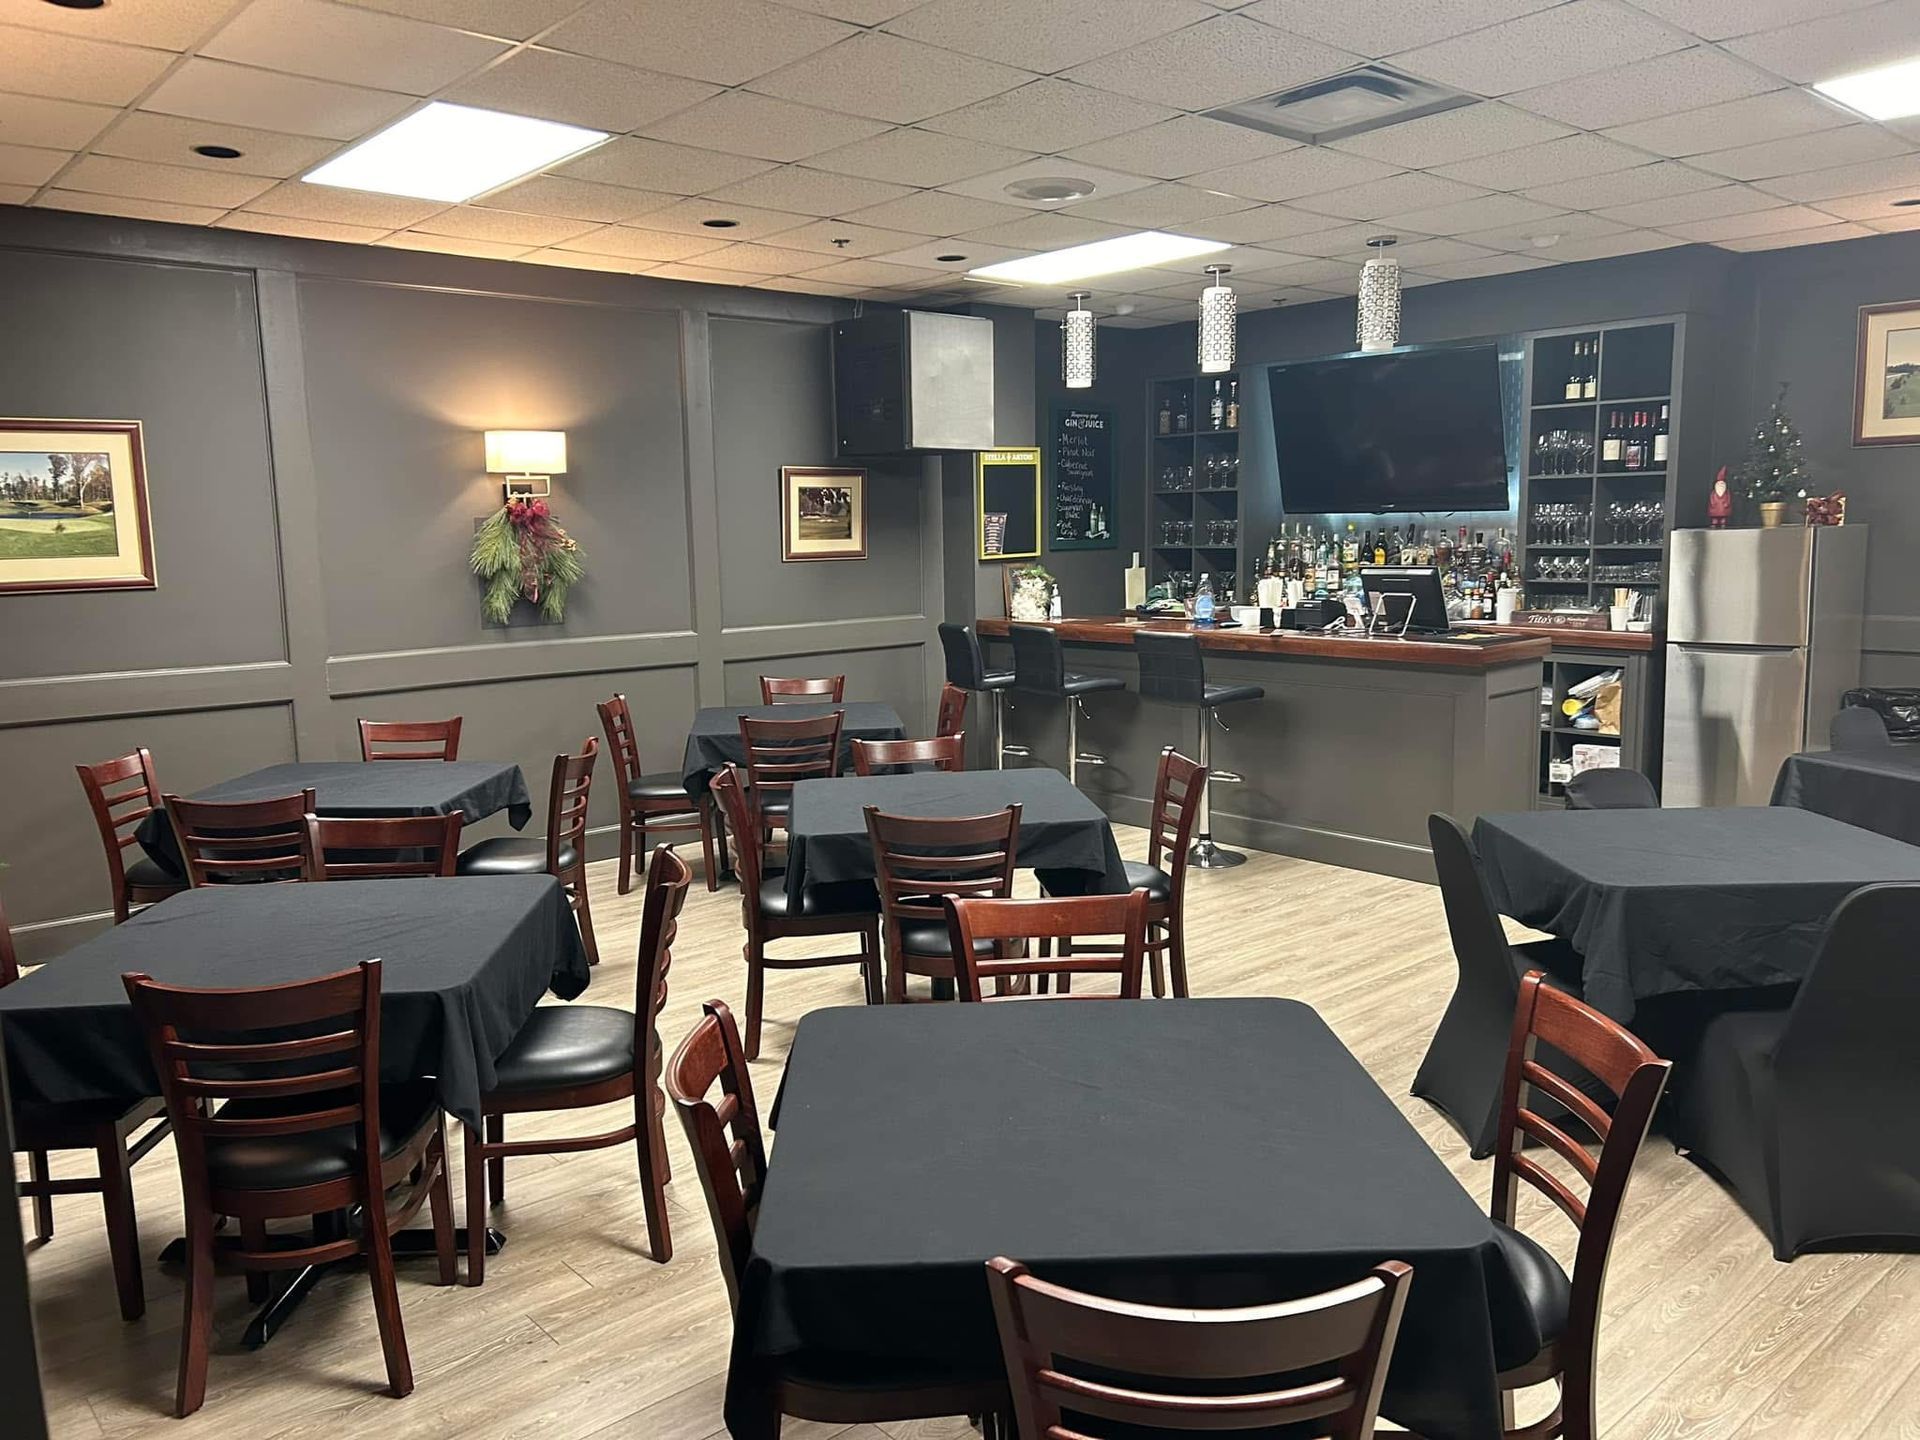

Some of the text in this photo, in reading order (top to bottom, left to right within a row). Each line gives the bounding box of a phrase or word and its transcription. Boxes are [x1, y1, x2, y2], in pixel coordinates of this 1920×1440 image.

[1065, 418, 1078, 427] GIN
[1085, 420, 1104, 429] JUICE
[1062, 433, 1088, 446] Merlot
[1528, 614, 1553, 624] Tito's
